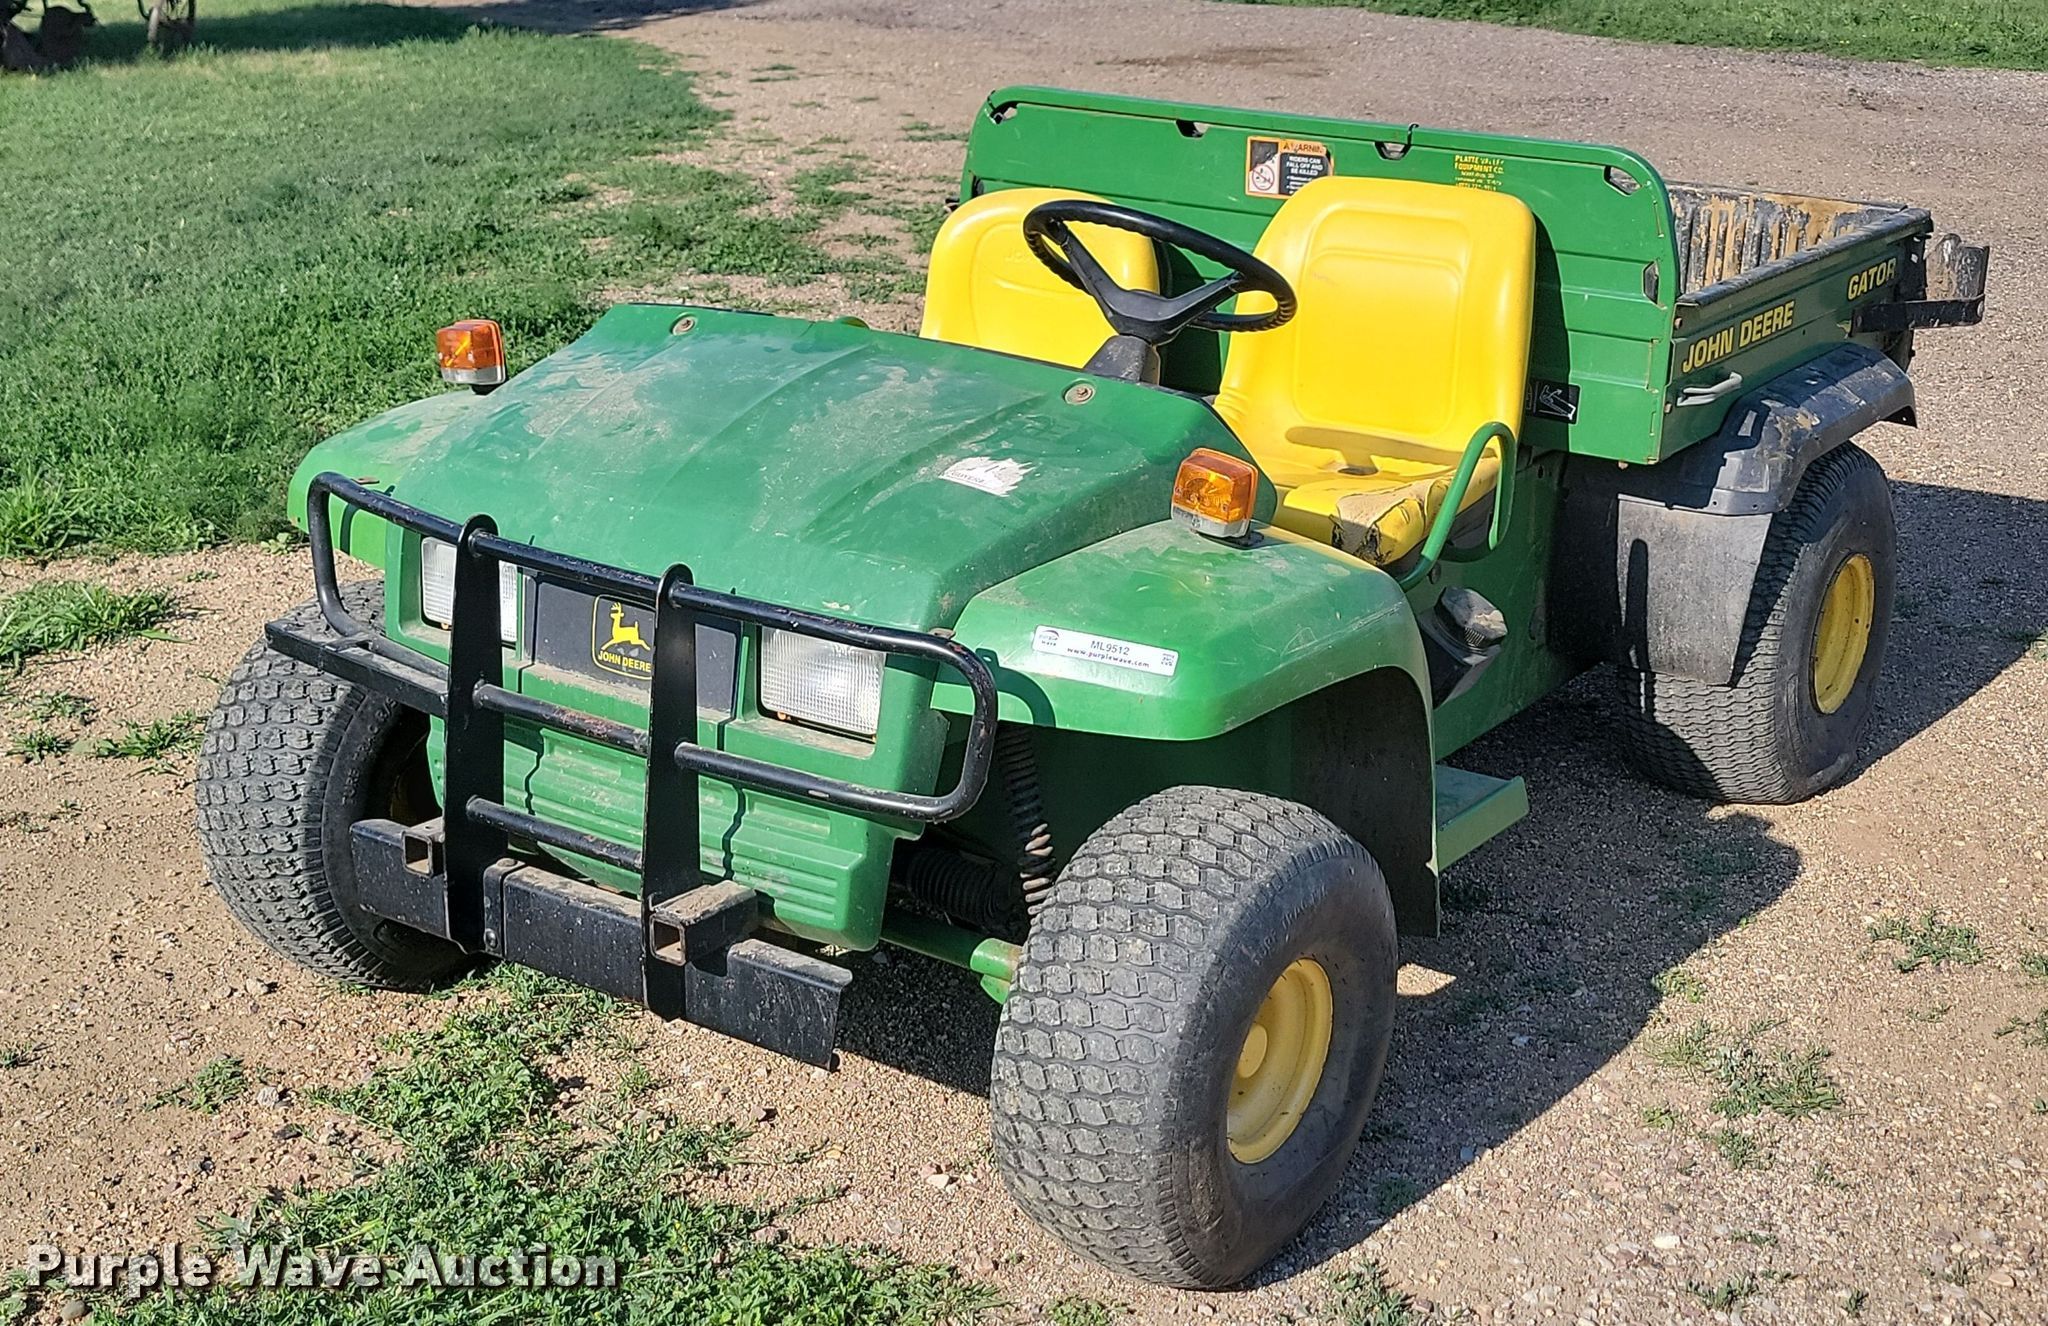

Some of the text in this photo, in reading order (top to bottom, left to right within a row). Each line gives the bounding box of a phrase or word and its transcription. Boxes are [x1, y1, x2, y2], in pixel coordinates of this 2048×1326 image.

[1309, 157, 1321, 165] CAN
[1455, 155, 1479, 164] PLATTE
[1847, 257, 1897, 301] GATOR
[1681, 300, 1796, 374] JOHN DEERE
[1067, 647, 1150, 668] www.purplewave.com
[1090, 640, 1130, 656] ML9512
[597, 650, 652, 673] JOHN DEERE
